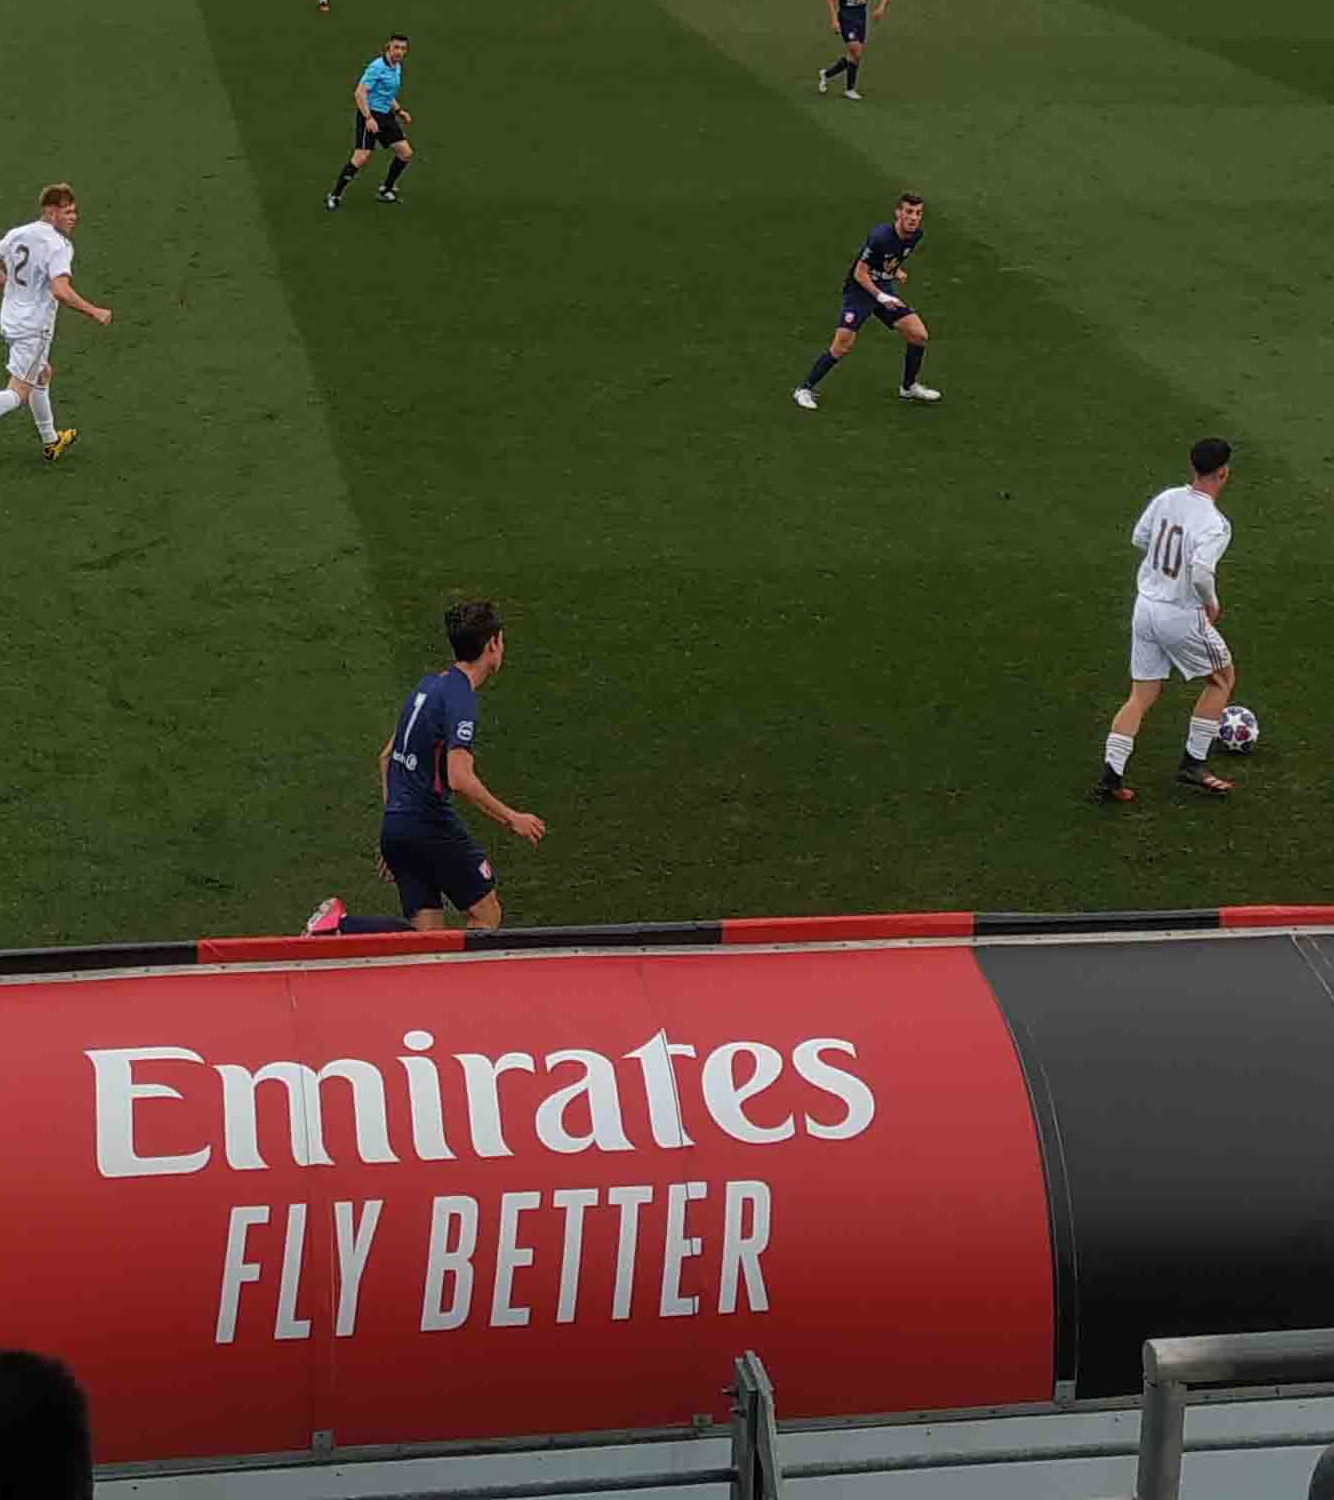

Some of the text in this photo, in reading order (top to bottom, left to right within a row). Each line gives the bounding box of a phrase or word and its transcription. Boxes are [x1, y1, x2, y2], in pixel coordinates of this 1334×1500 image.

[14, 244, 29, 287] 2
[1153, 518, 1183, 580] 10
[86, 1029, 874, 1178] Emirates
[215, 1180, 772, 1344] FLY BETTER
